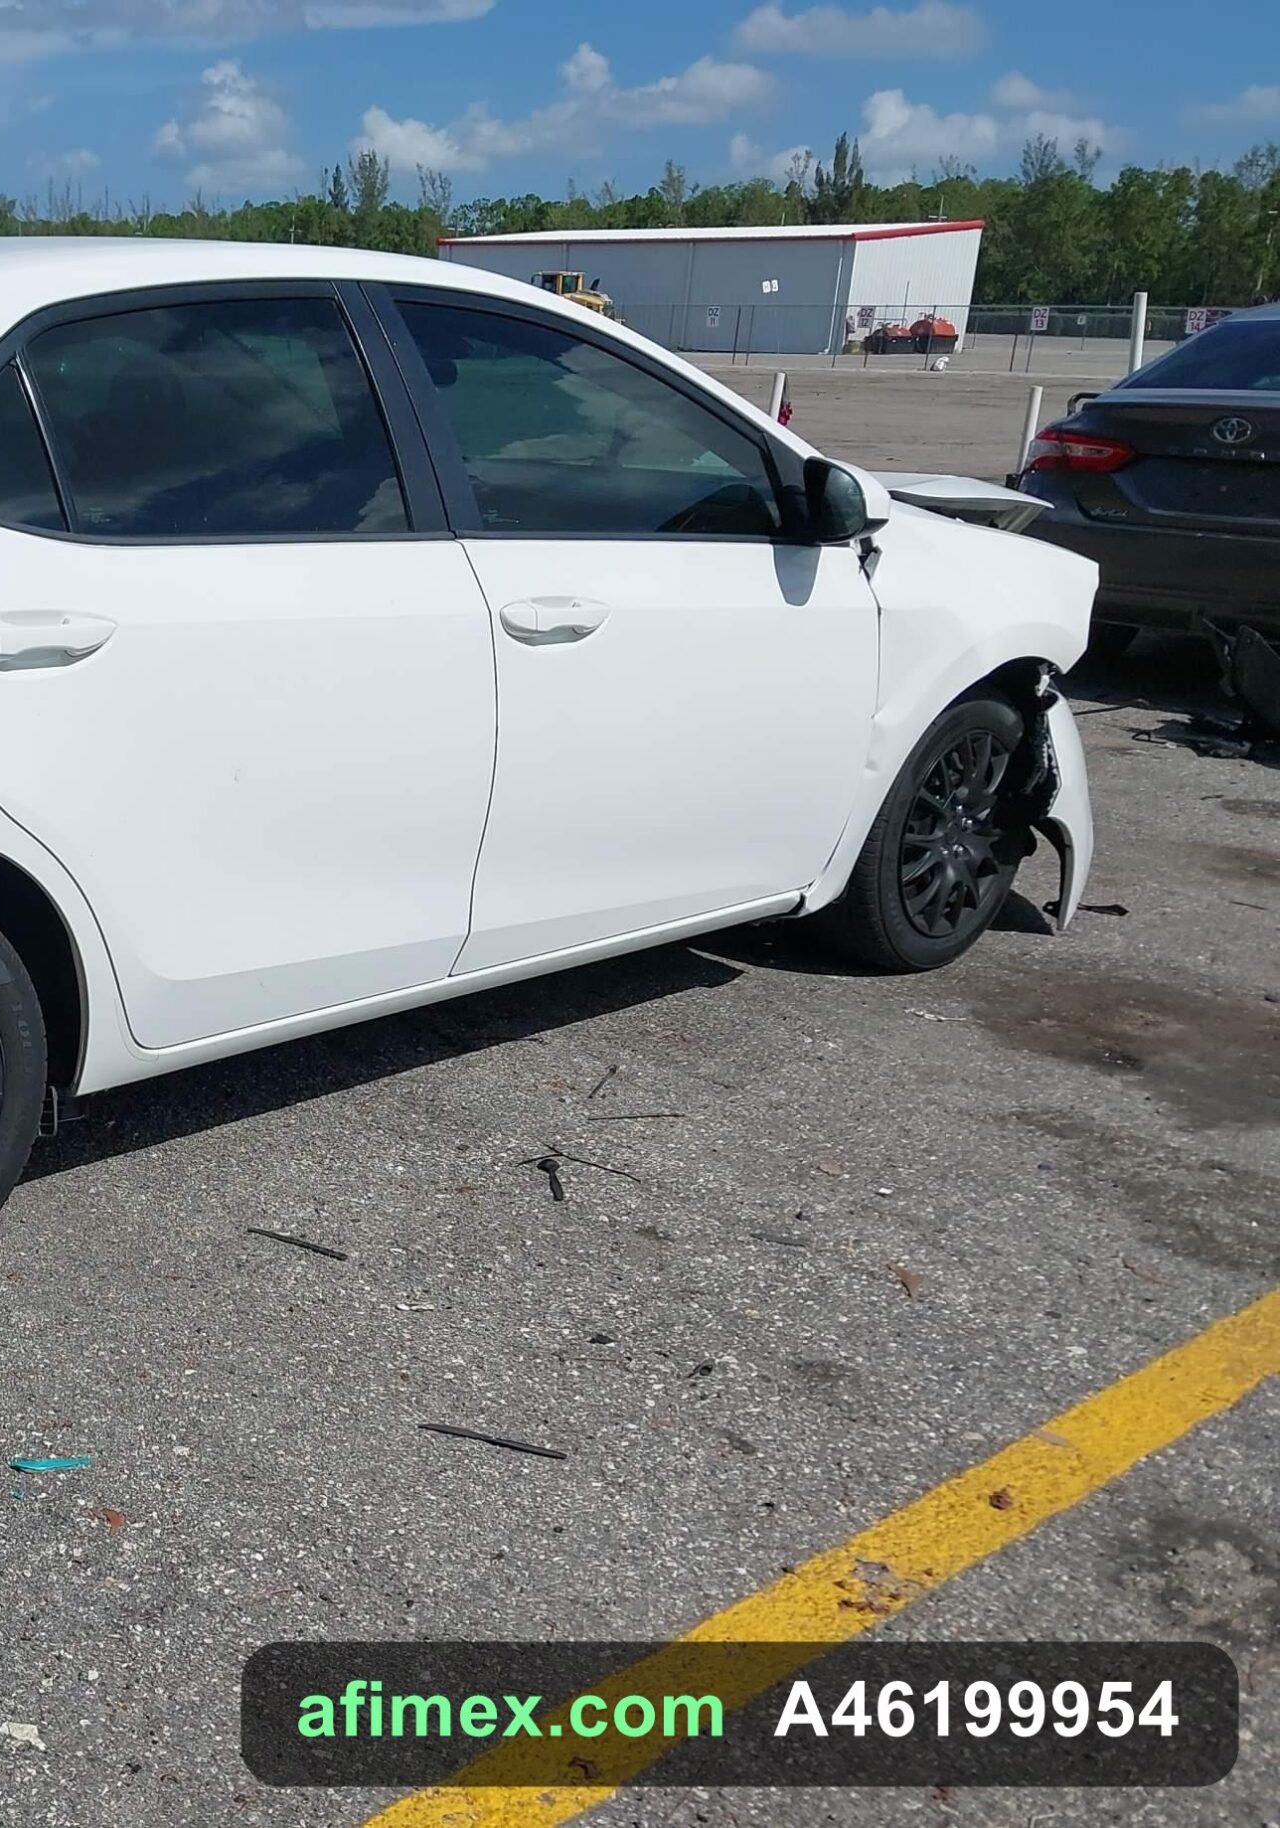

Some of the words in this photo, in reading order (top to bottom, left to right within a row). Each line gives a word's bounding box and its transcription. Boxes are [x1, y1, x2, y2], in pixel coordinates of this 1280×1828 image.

[708, 307, 720, 317] DZ
[860, 308, 874, 318] DZ
[1034, 308, 1048, 319] DZ
[1189, 310, 1205, 321] DZ
[861, 318, 869, 327] 12
